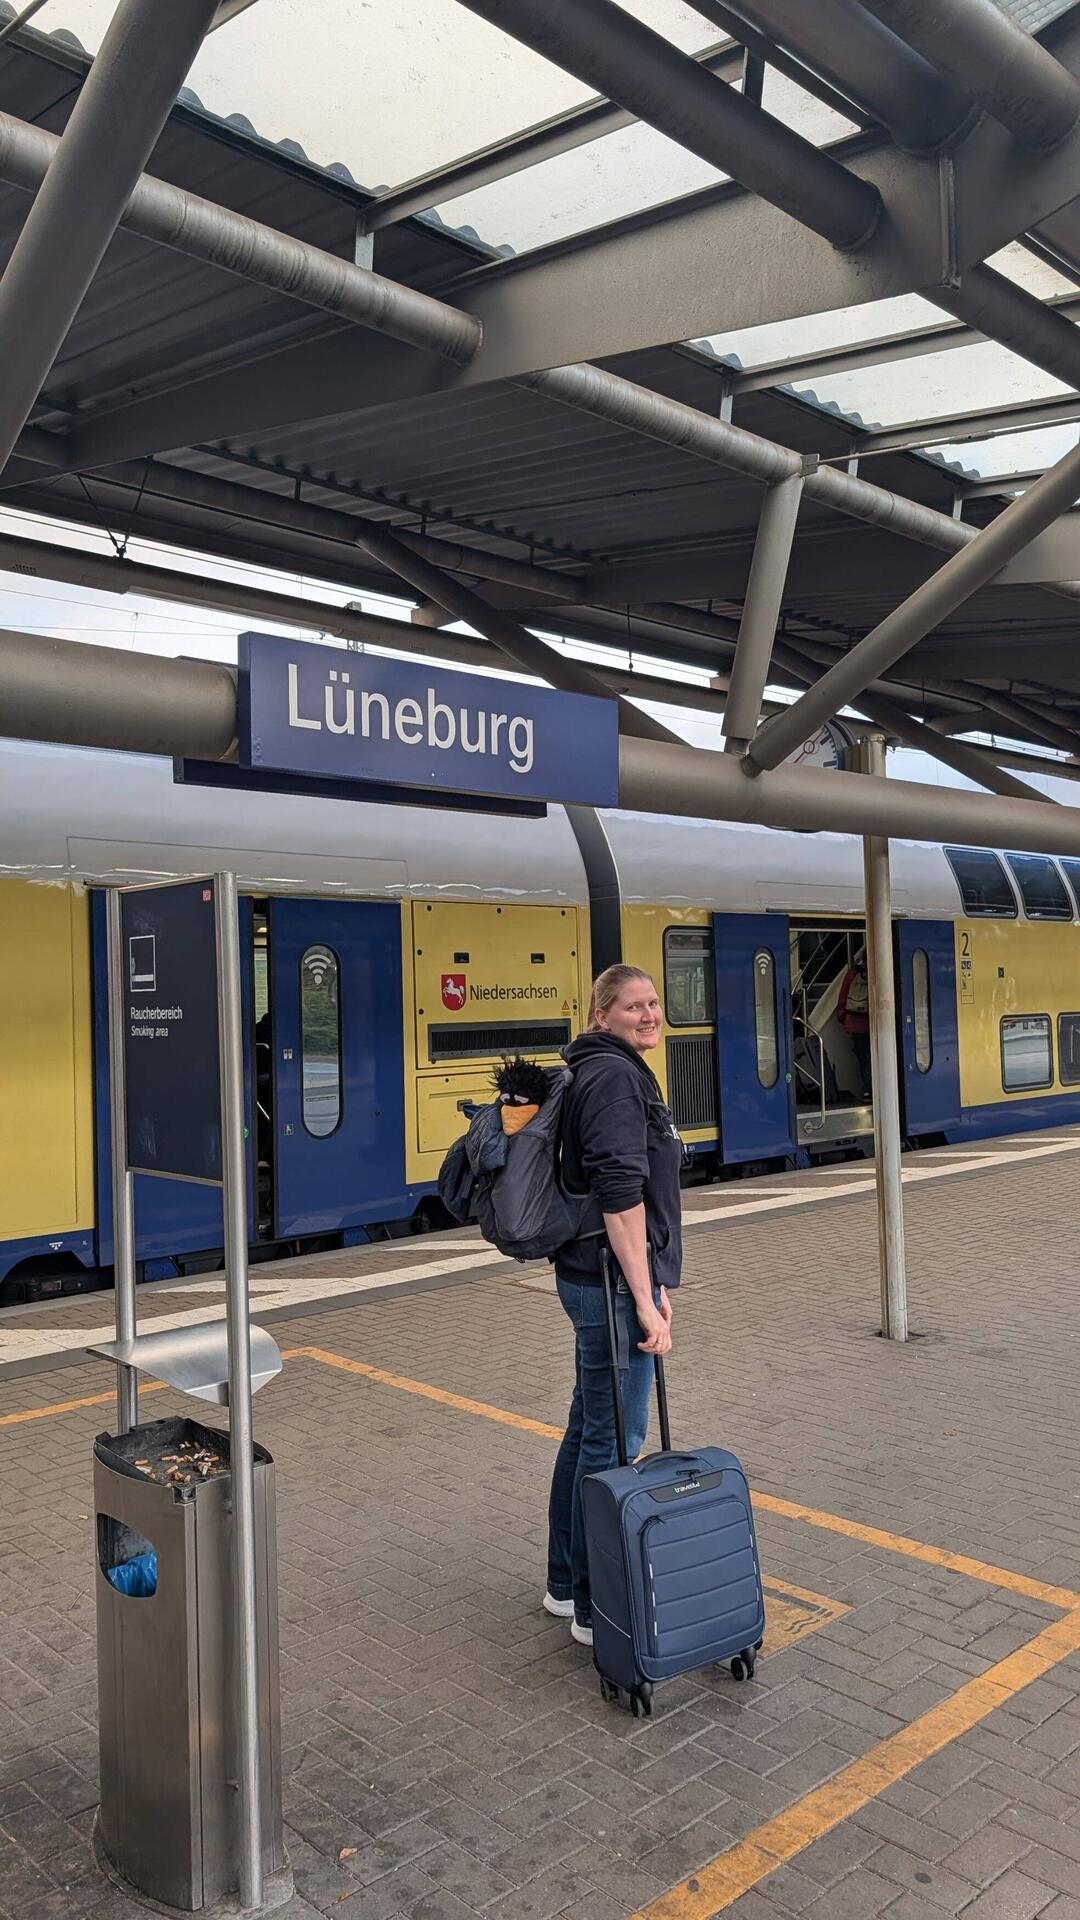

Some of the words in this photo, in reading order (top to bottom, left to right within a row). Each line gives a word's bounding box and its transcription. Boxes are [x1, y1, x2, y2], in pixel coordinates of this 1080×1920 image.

[287, 663, 535, 774] Lüneburg
[961, 932, 970, 956] 2
[469, 983, 558, 1001] Niedersachsen
[130, 1005, 183, 1020] Raucherbereich
[131, 1025, 155, 1039] Smoking
[155, 1027, 169, 1037] area
